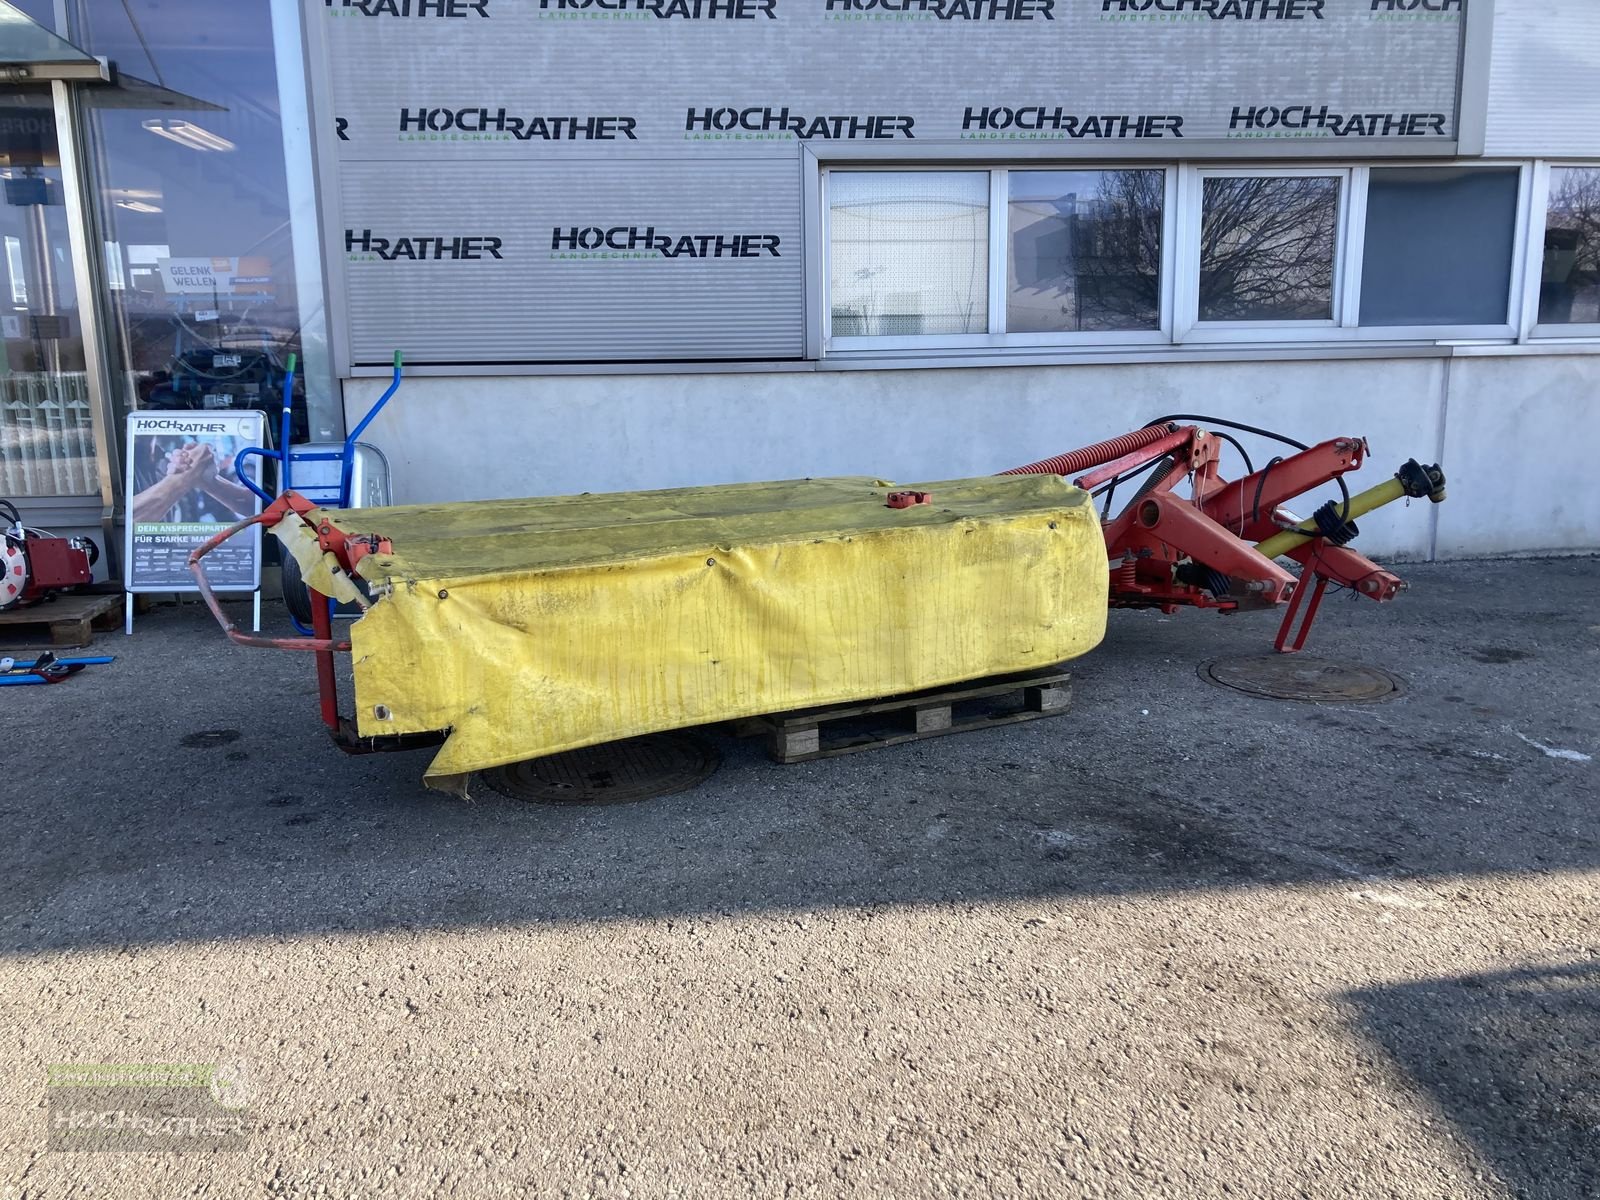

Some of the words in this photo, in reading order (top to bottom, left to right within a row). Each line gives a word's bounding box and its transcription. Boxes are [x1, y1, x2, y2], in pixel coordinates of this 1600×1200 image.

[325, 0, 490, 17] RATHER
[539, 12, 650, 20] LANDTECHNIK
[825, 13, 932, 21] LANDTECHNIK
[1100, 13, 1206, 22] LANDTECHNIK
[400, 107, 638, 140] HOCHRATHER
[686, 107, 915, 139] HOCHRATHER
[962, 106, 1184, 138] HOCHRATHER
[1229, 105, 1446, 136] HOCHRATHER
[684, 132, 792, 140] LANDTECHNIK
[1226, 130, 1328, 138] LANDTECHNIK
[345, 229, 503, 261] HRATHER
[552, 226, 781, 258] HOCHRATHER
[550, 251, 658, 259] LANDTECHNIK
[170, 266, 211, 275] GELENK
[173, 277, 216, 286] WELLEN
[137, 420, 226, 432] HOCHRATHER
[134, 535, 153, 543] FÜR
[155, 535, 189, 543] STARKE
